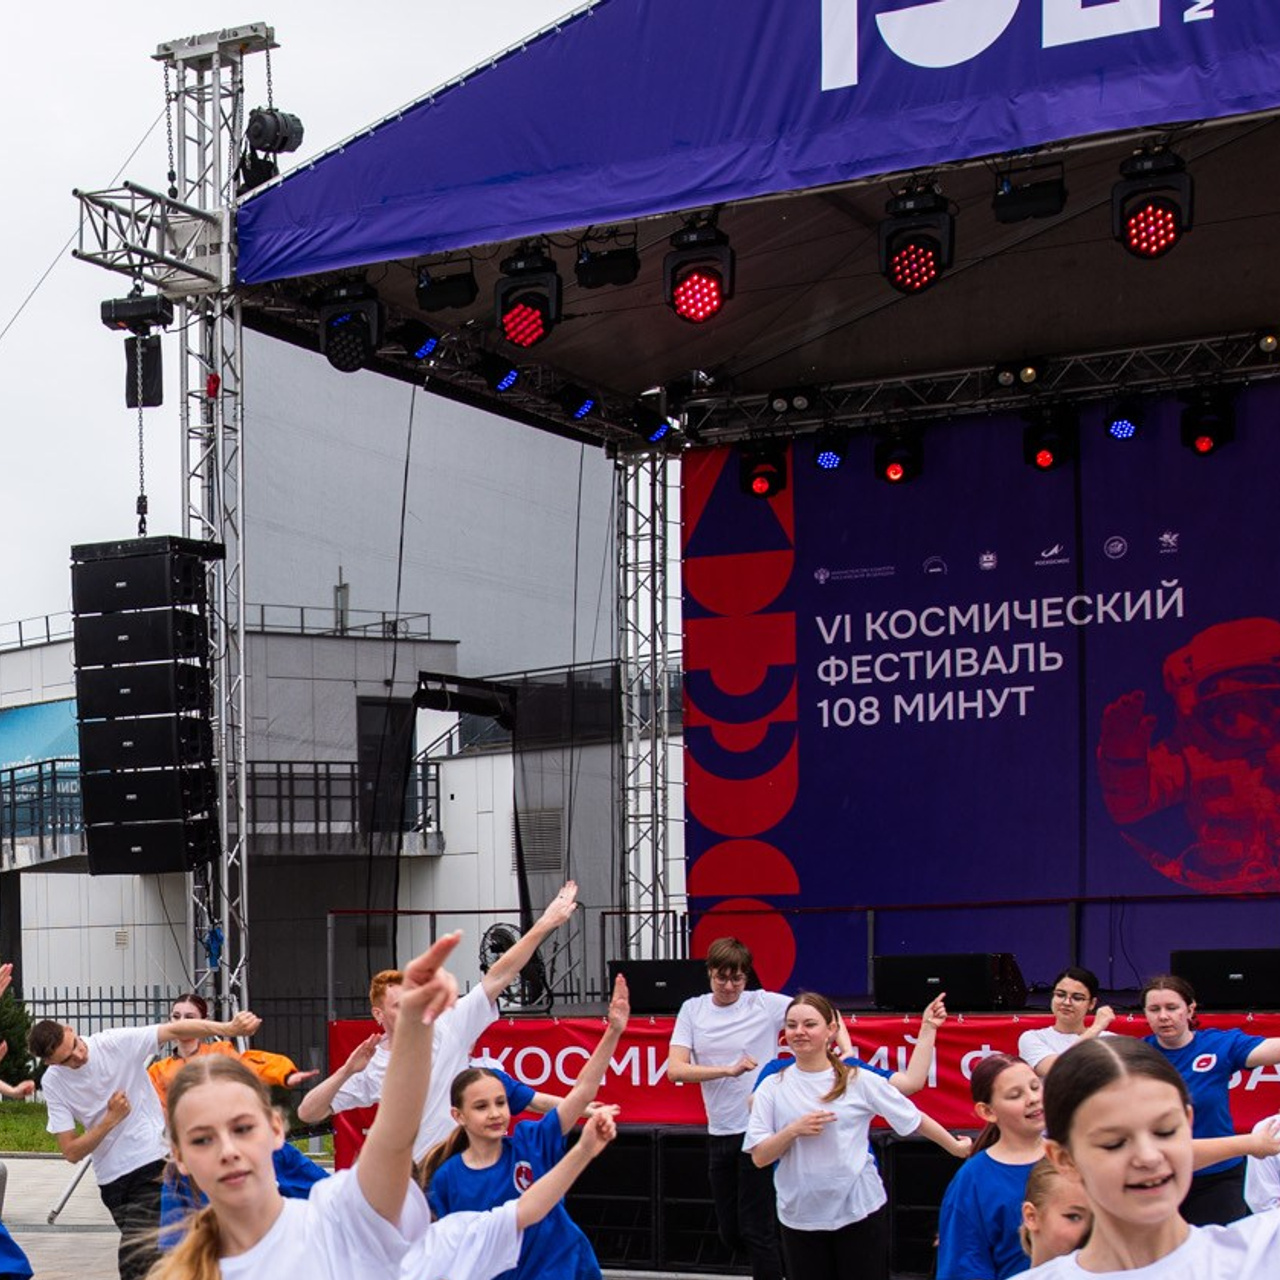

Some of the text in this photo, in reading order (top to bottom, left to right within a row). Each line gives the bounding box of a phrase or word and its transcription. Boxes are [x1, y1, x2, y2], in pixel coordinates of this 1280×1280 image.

[815, 579, 1184, 644] VI КОСМИЧЕСКИЙ
[817, 641, 1064, 686] ФЕСТИВАЛЬ
[816, 685, 1035, 728] 108 МИНУТ
